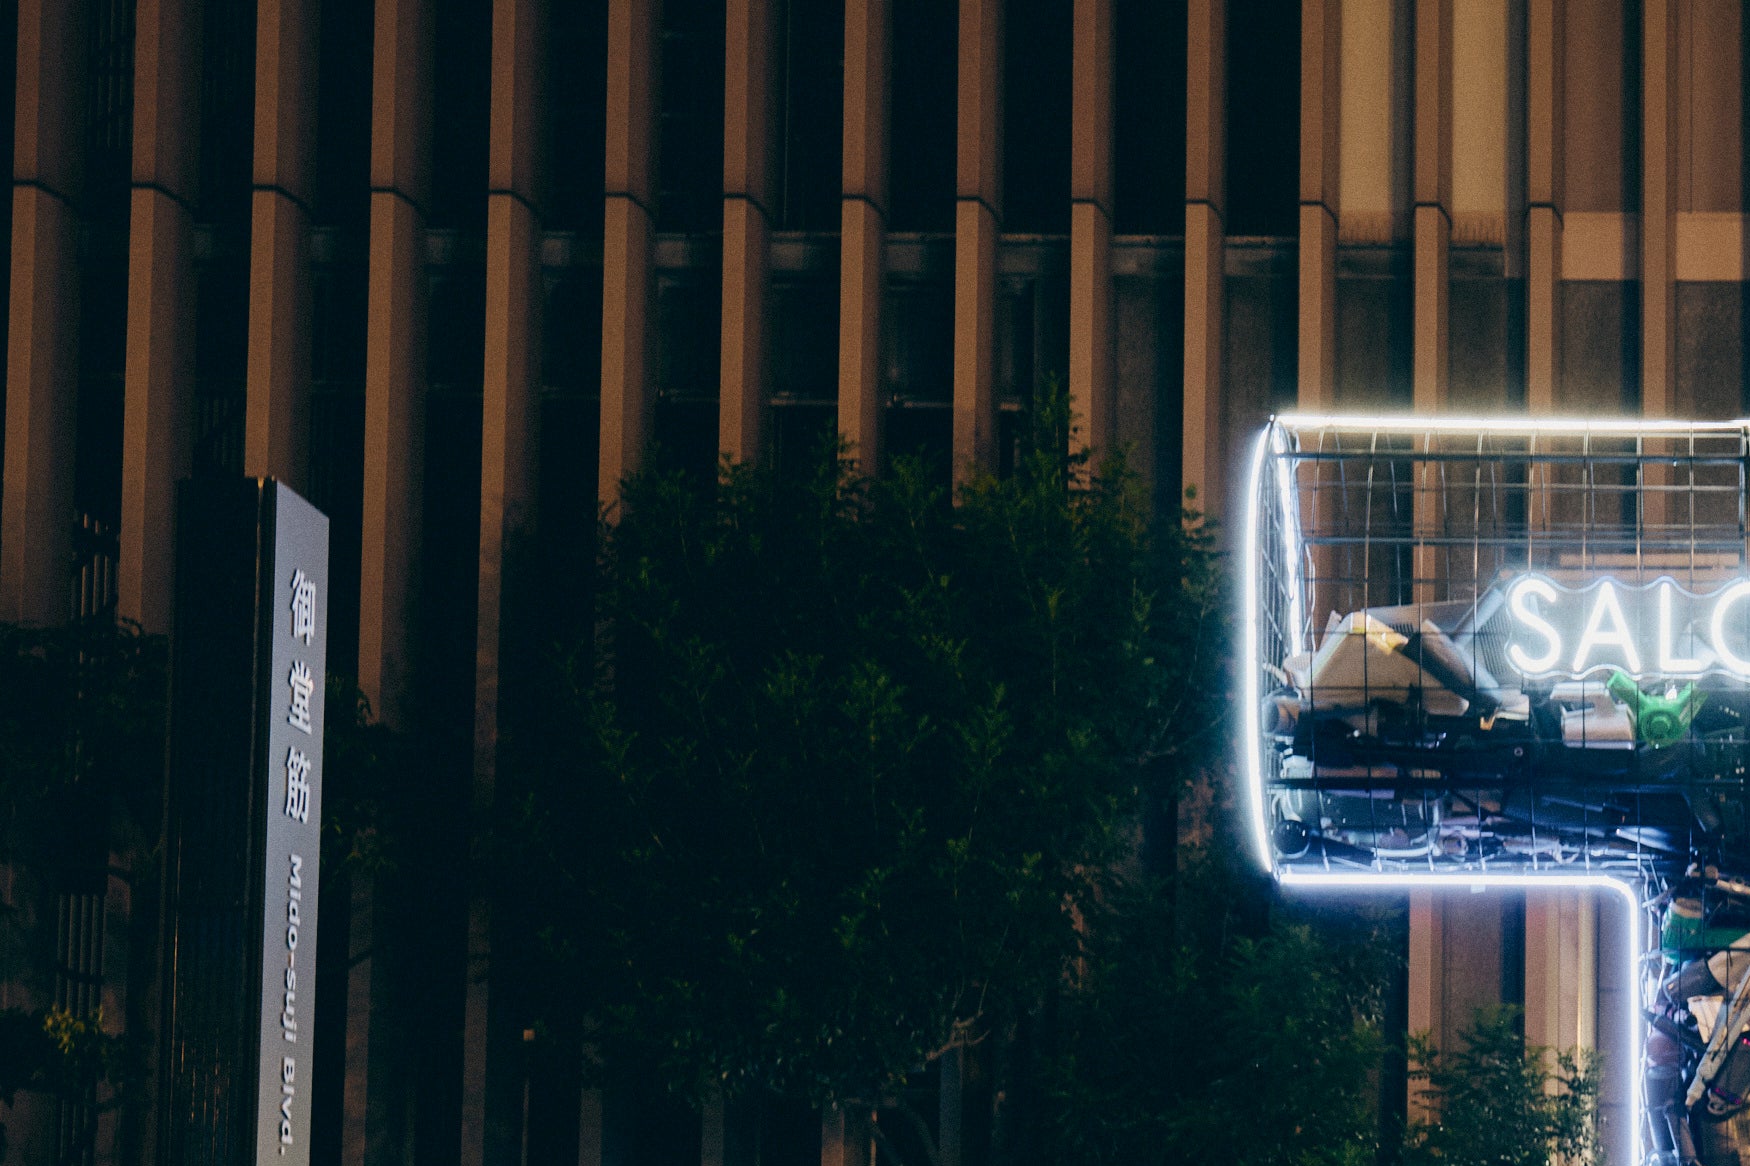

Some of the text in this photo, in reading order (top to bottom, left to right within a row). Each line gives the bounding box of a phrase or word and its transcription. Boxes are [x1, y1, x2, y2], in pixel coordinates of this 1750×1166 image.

[286, 568, 316, 826] 御堂筋
[281, 854, 302, 1156] Mido-suji Blvd.
